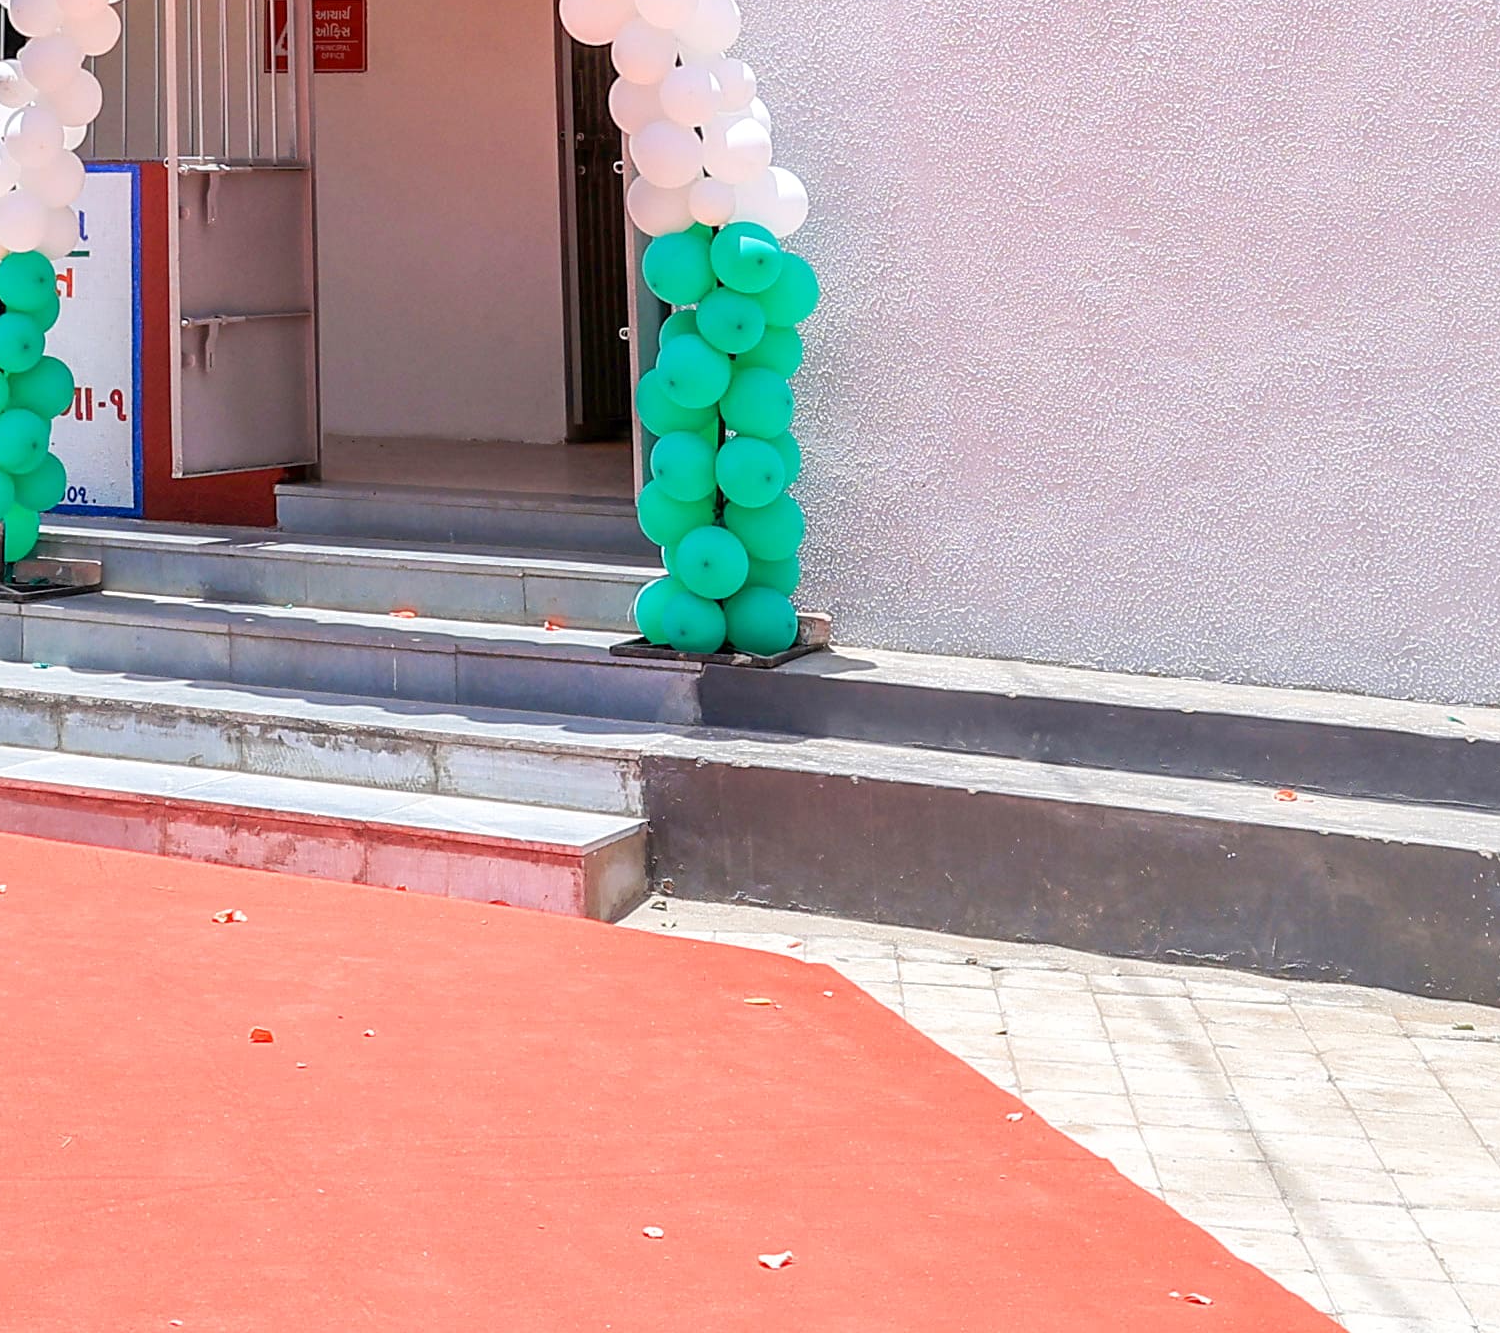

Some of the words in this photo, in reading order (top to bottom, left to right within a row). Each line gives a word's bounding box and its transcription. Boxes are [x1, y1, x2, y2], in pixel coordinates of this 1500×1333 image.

[315, 5, 352, 21] આચાર્ય
[315, 22, 351, 39] ઓફિસ
[315, 44, 352, 52] PRINCIPAL
[321, 52, 345, 60] OFFICE
